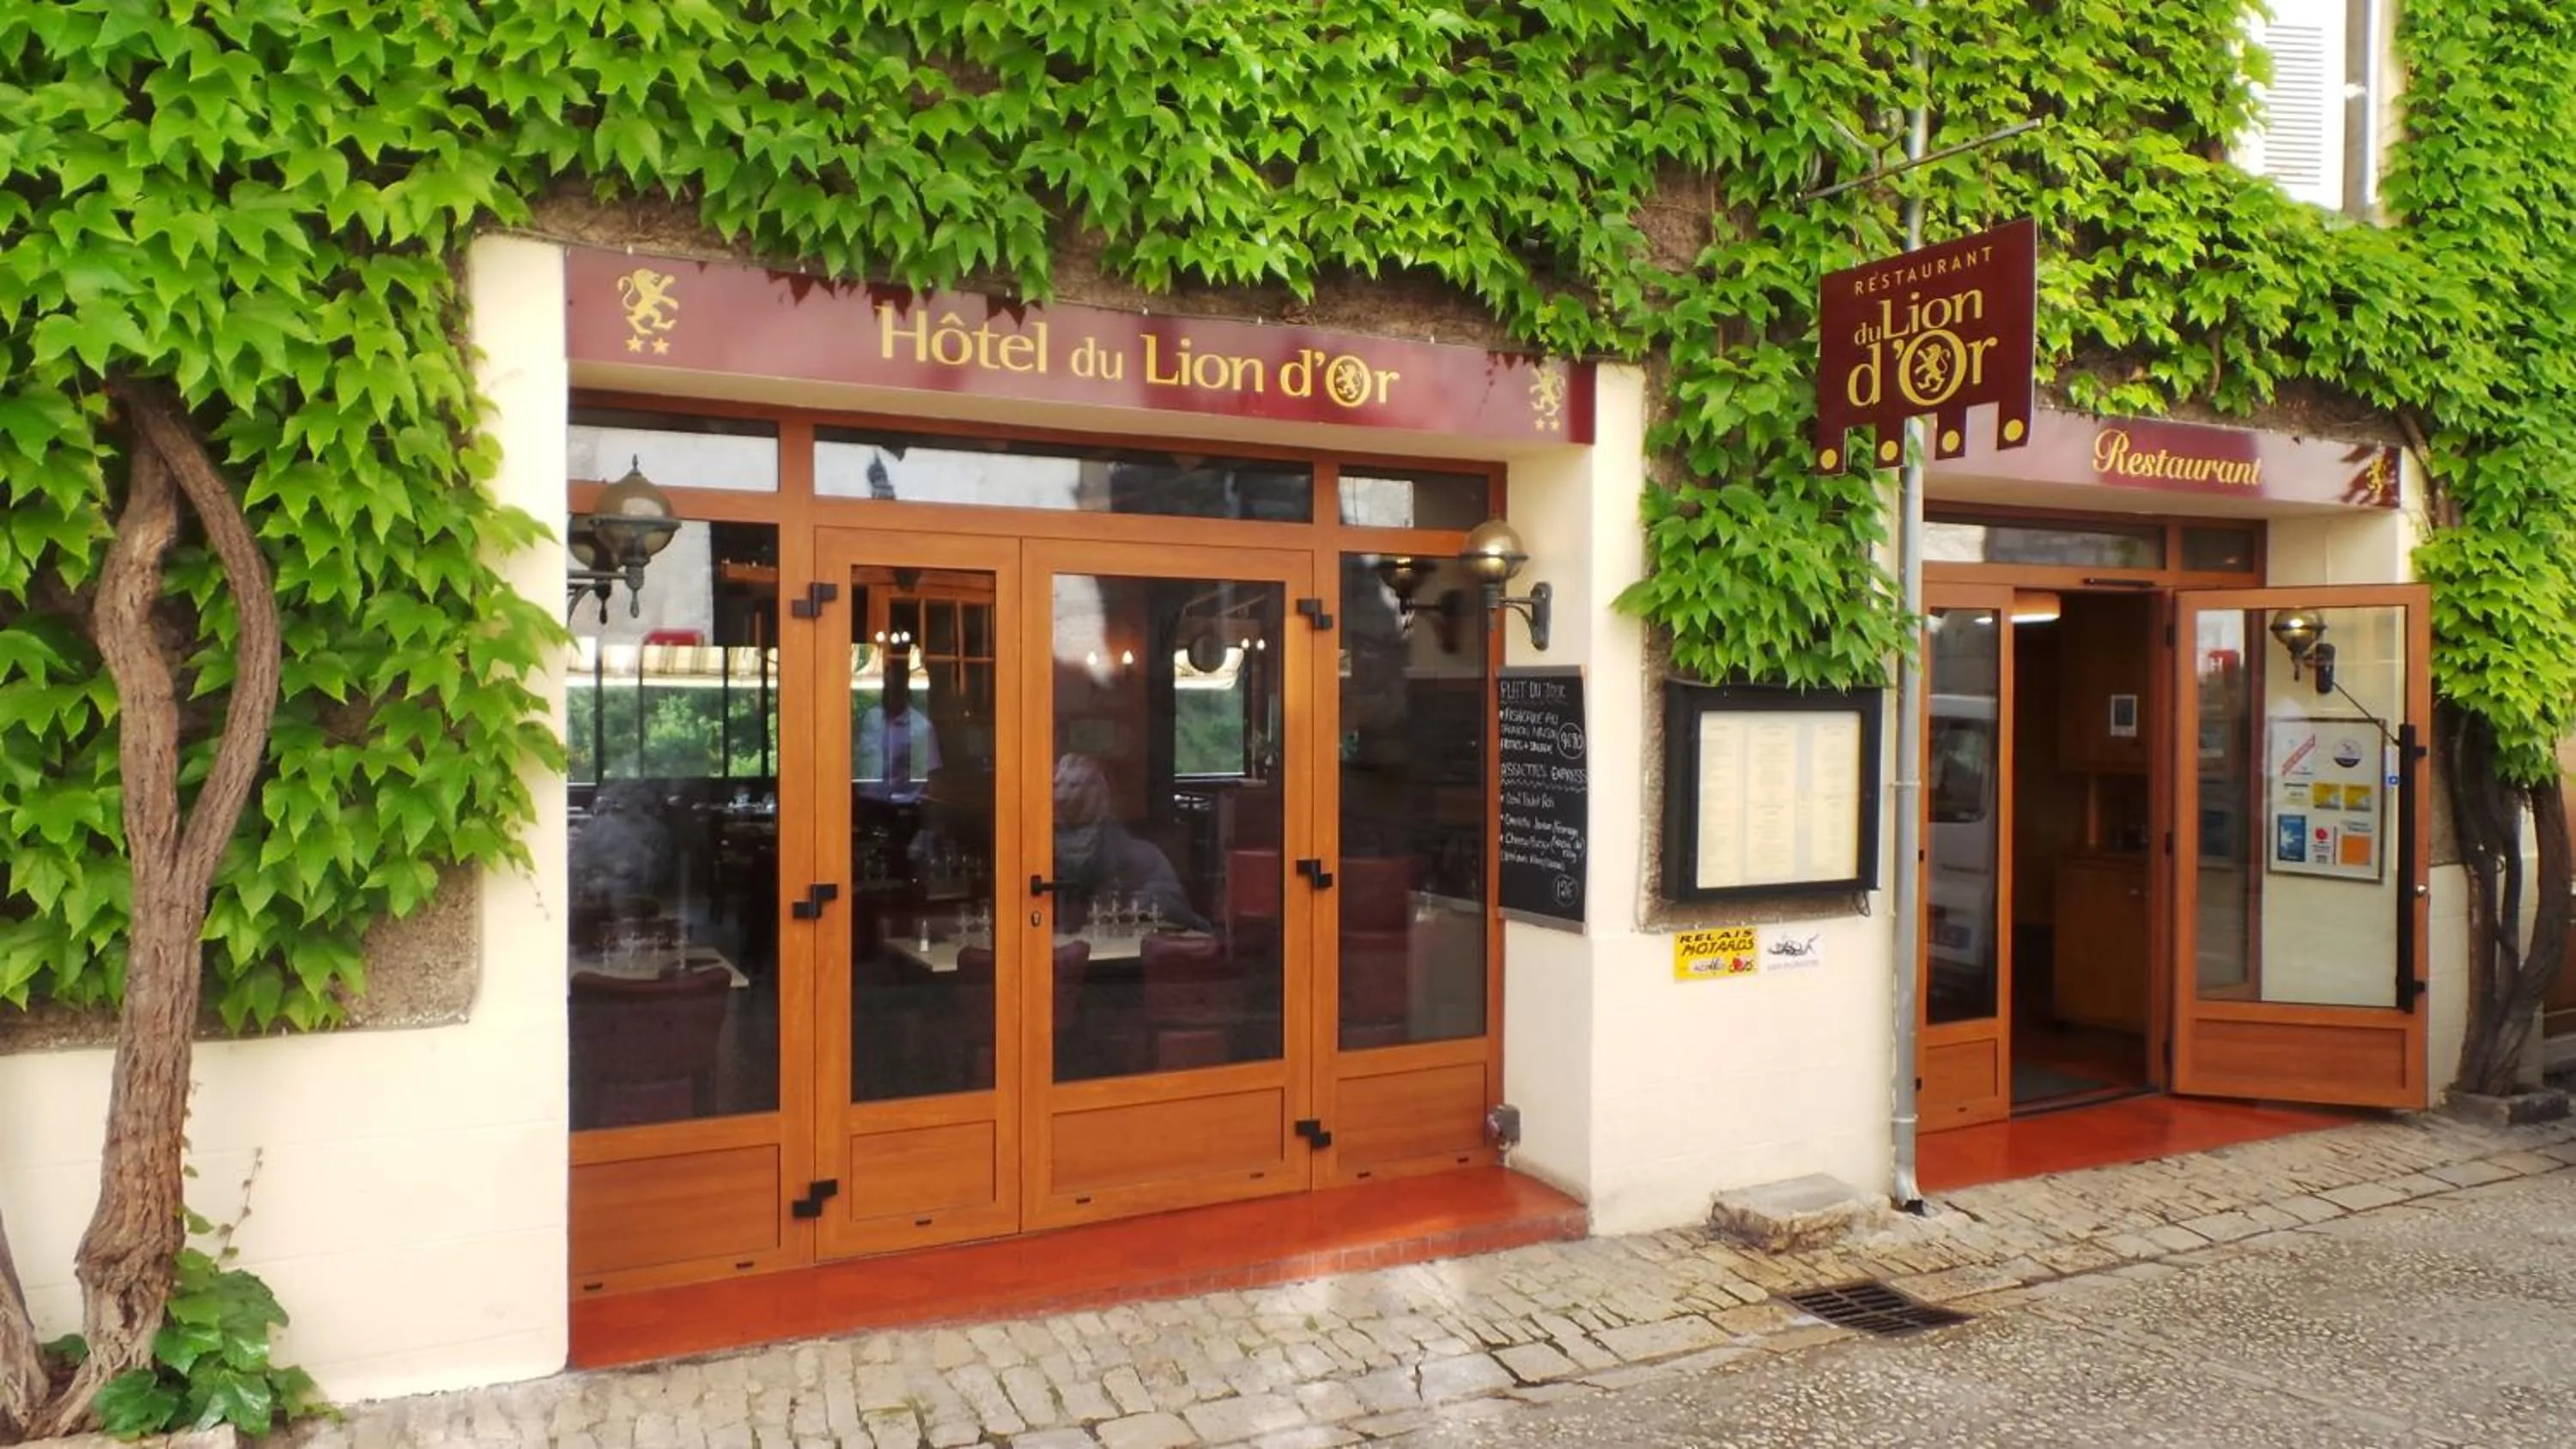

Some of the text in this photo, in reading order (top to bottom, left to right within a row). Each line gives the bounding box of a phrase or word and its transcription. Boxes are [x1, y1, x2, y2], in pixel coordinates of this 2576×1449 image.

[1854, 288, 1983, 346] du Lion
[874, 300, 1400, 409] Hôtel du Lion d'Or
[1848, 329, 1998, 407] d'Or
[2093, 428, 2263, 485] Restaurant
[1680, 929, 1753, 943] RELAIS
[1682, 937, 1755, 957] MOTARDS
